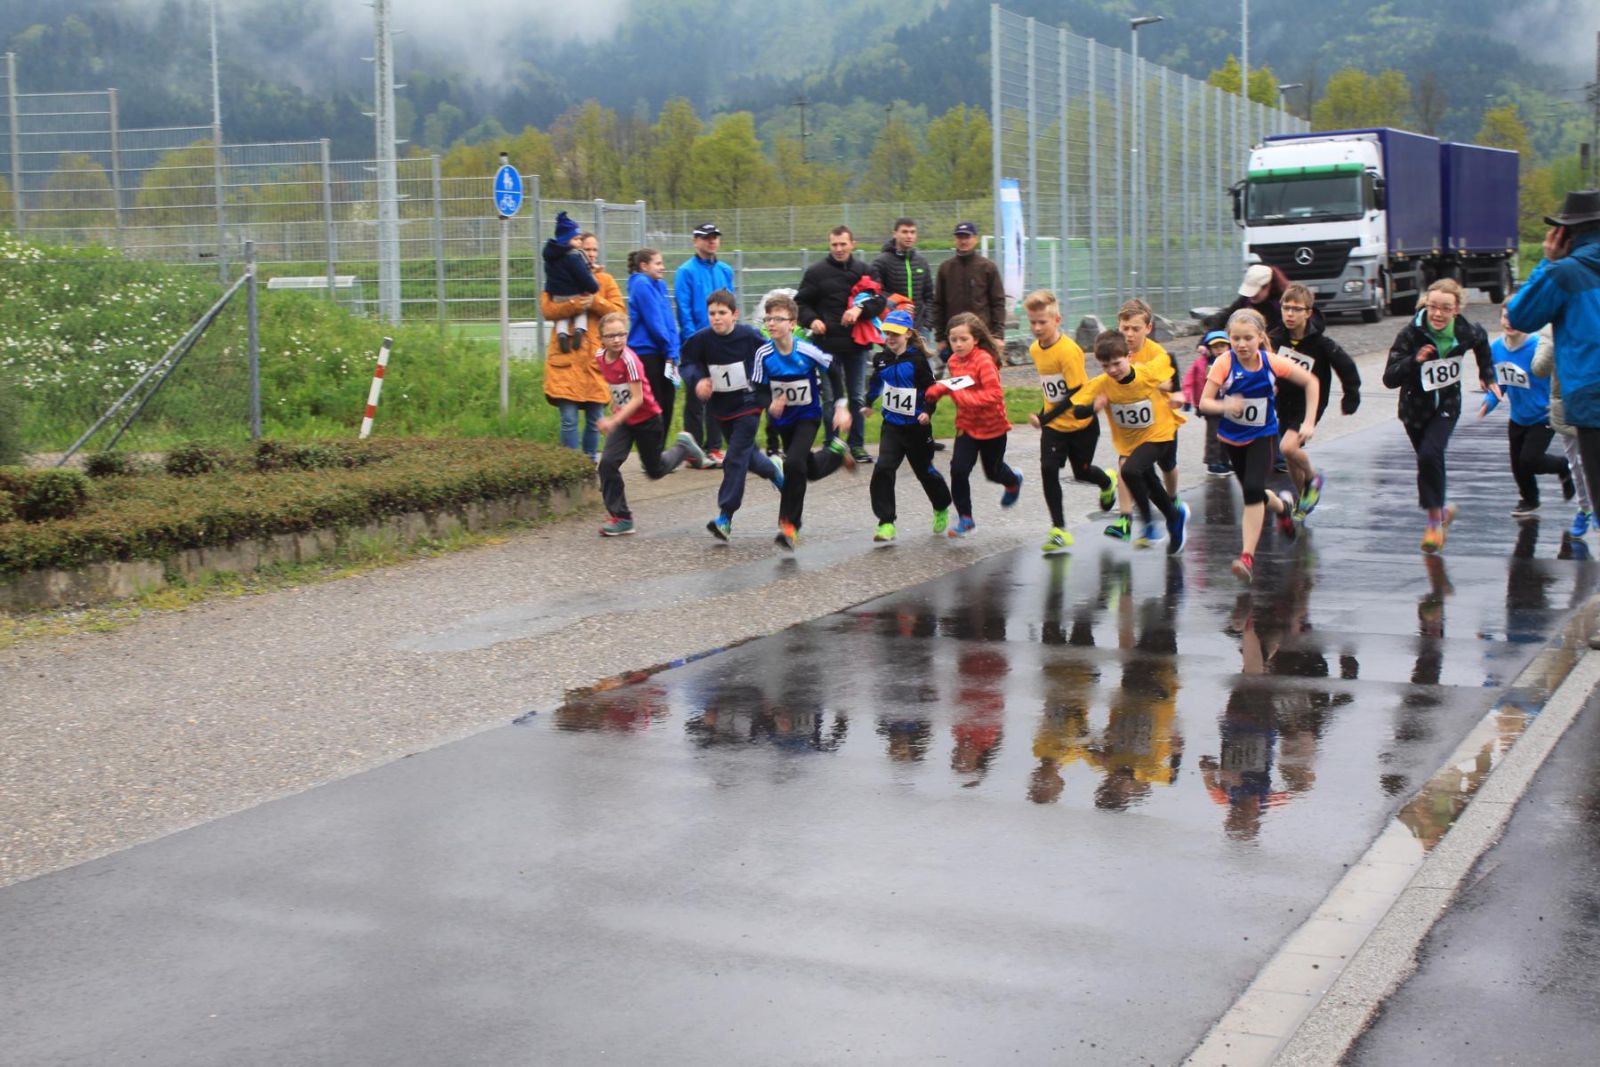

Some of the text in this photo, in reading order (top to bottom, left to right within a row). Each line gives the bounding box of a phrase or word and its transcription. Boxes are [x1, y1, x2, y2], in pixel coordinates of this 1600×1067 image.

[721, 371, 731, 387] 1
[1425, 362, 1460, 384] 180
[1042, 380, 1068, 398] 199
[885, 391, 913, 411] 114
[1116, 407, 1151, 425] 130
